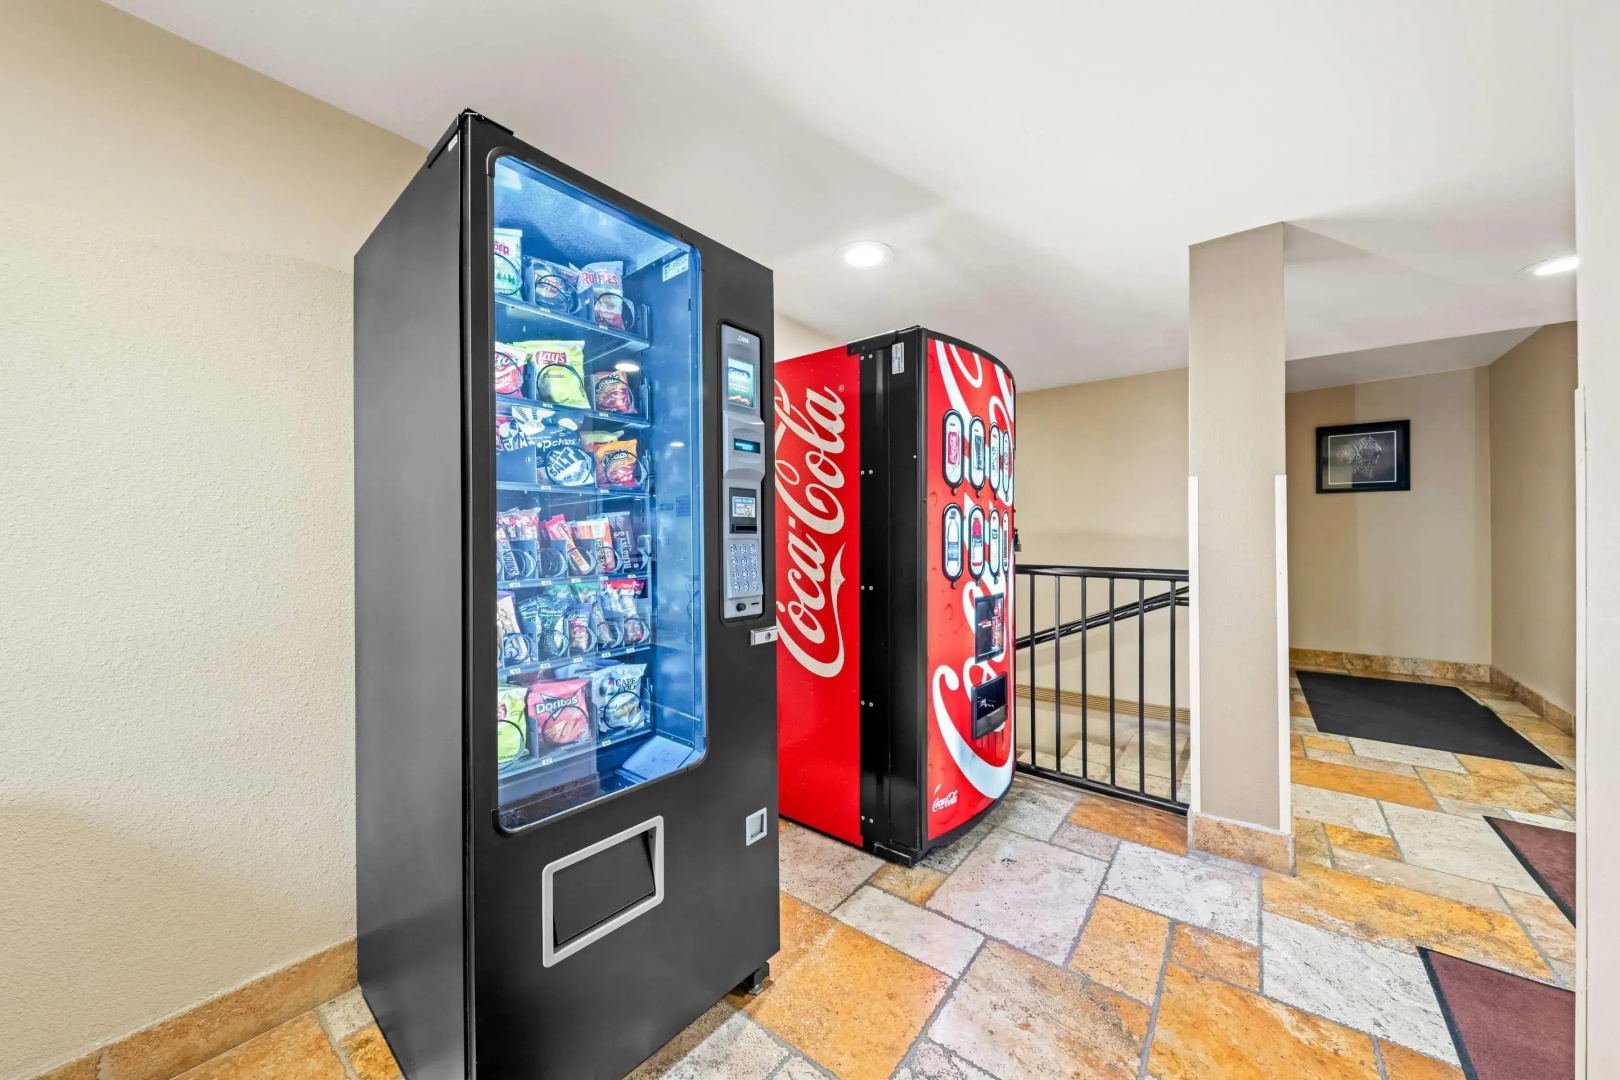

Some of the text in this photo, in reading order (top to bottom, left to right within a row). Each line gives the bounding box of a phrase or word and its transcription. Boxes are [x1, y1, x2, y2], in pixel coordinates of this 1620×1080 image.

[580, 271, 619, 287] RUFFLES
[549, 447, 576, 477] SALT
[774, 379, 845, 677] Coca-Cola
[535, 695, 579, 715] Doritos
[932, 790, 958, 813] Coca-Cola
